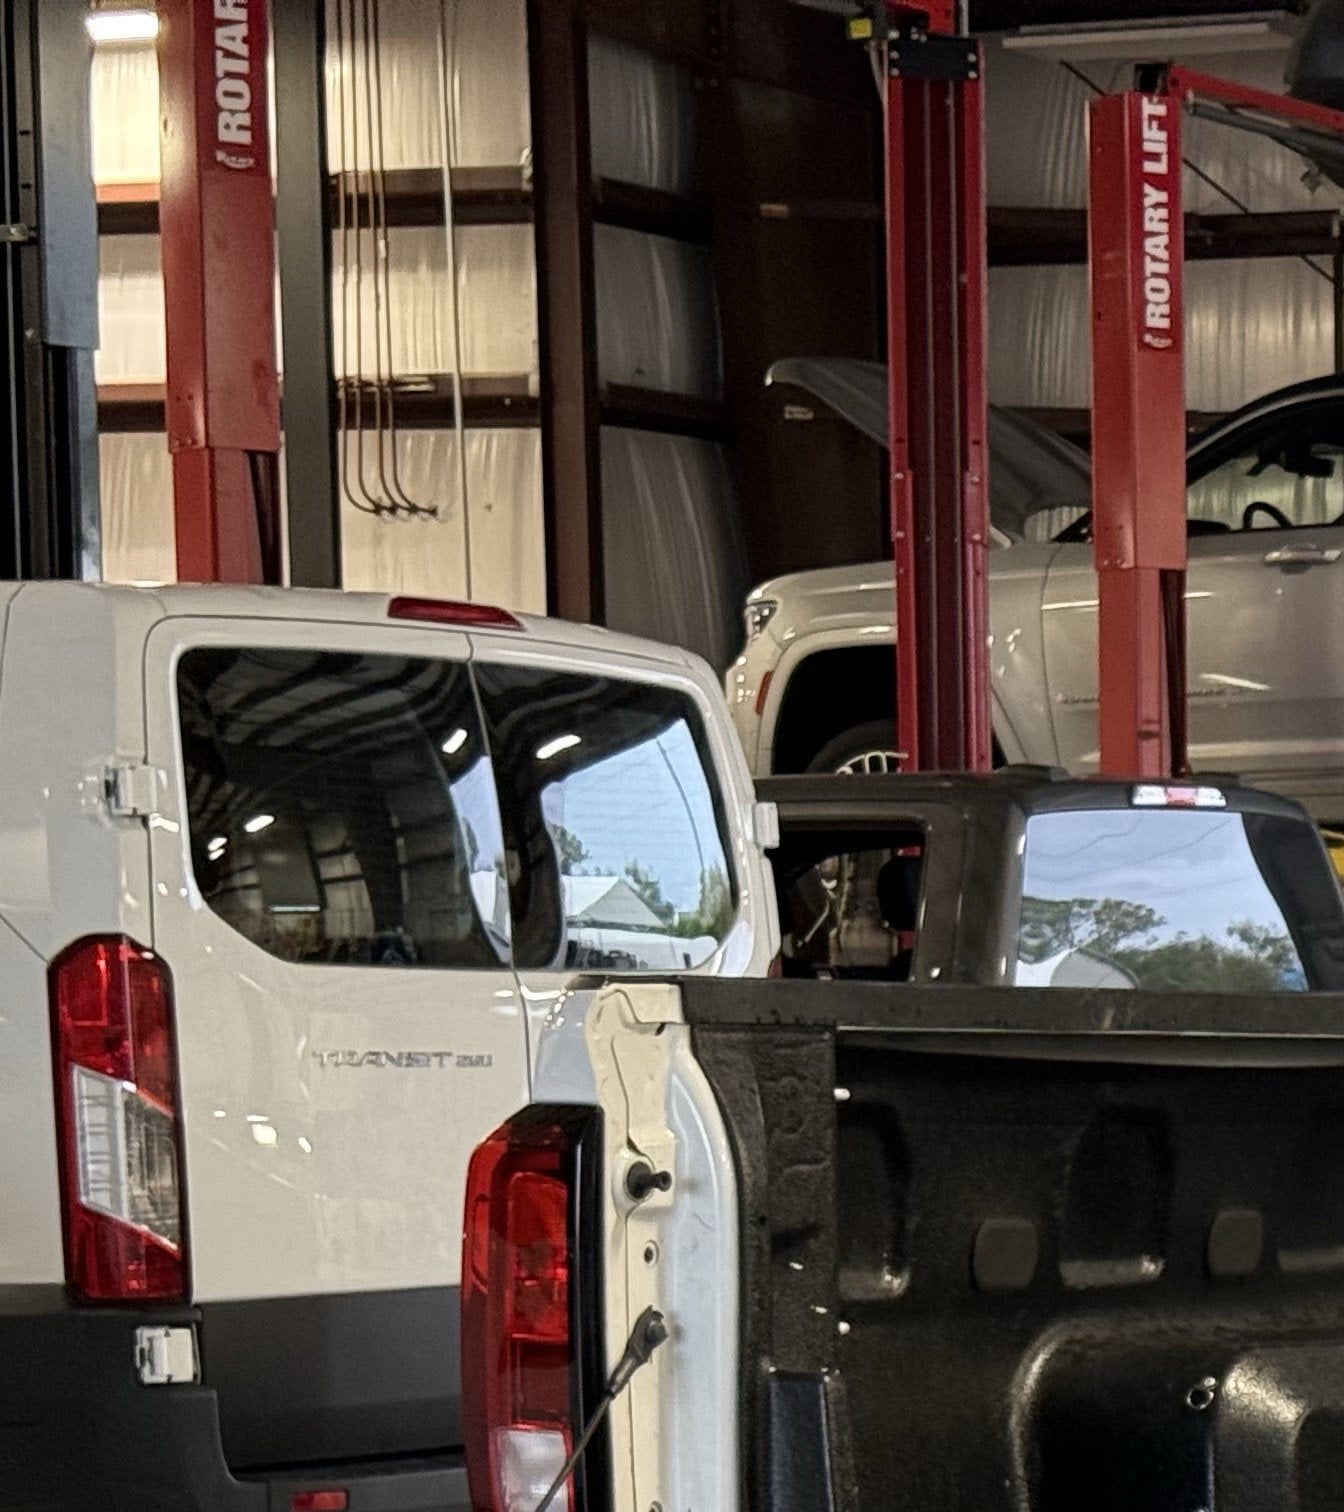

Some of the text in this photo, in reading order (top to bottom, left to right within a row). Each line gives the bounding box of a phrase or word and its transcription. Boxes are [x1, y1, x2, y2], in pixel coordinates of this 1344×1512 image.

[1142, 96, 1171, 328] ROTARY LIFT
[312, 1050, 453, 1069] TRANSIT
